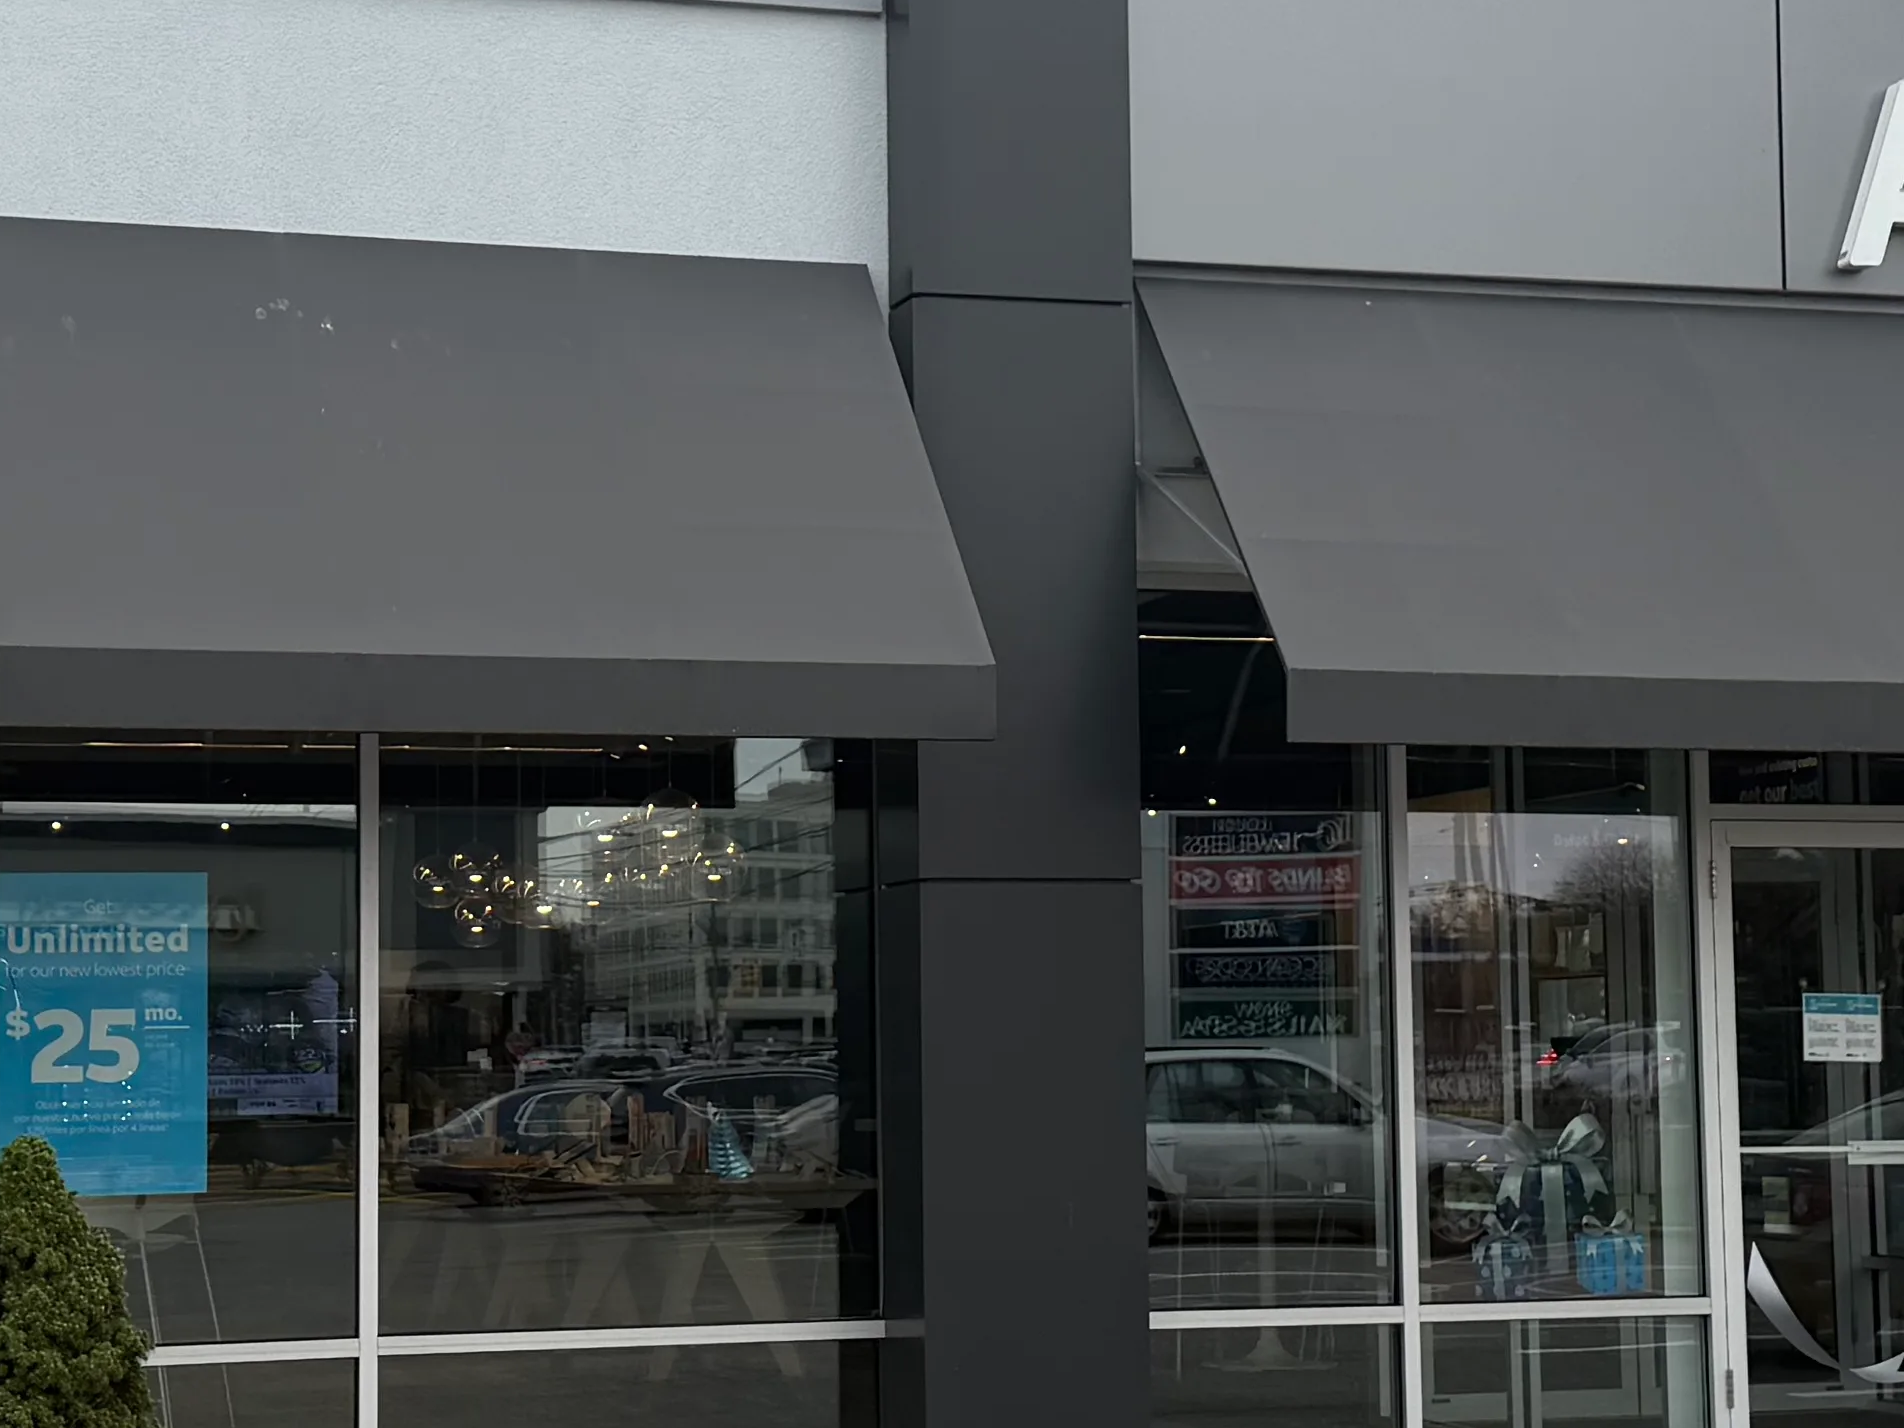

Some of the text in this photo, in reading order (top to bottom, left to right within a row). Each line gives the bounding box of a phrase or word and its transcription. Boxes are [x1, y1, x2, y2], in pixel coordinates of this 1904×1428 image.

[1764, 785, 1787, 803] our
[84, 899, 113, 914] Get
[7, 923, 189, 954] Unlimited
[5, 963, 25, 978] for
[30, 967, 56, 977] our
[59, 966, 91, 977] new
[94, 962, 142, 976] lowest
[6, 1007, 183, 1083] $25 mo.
